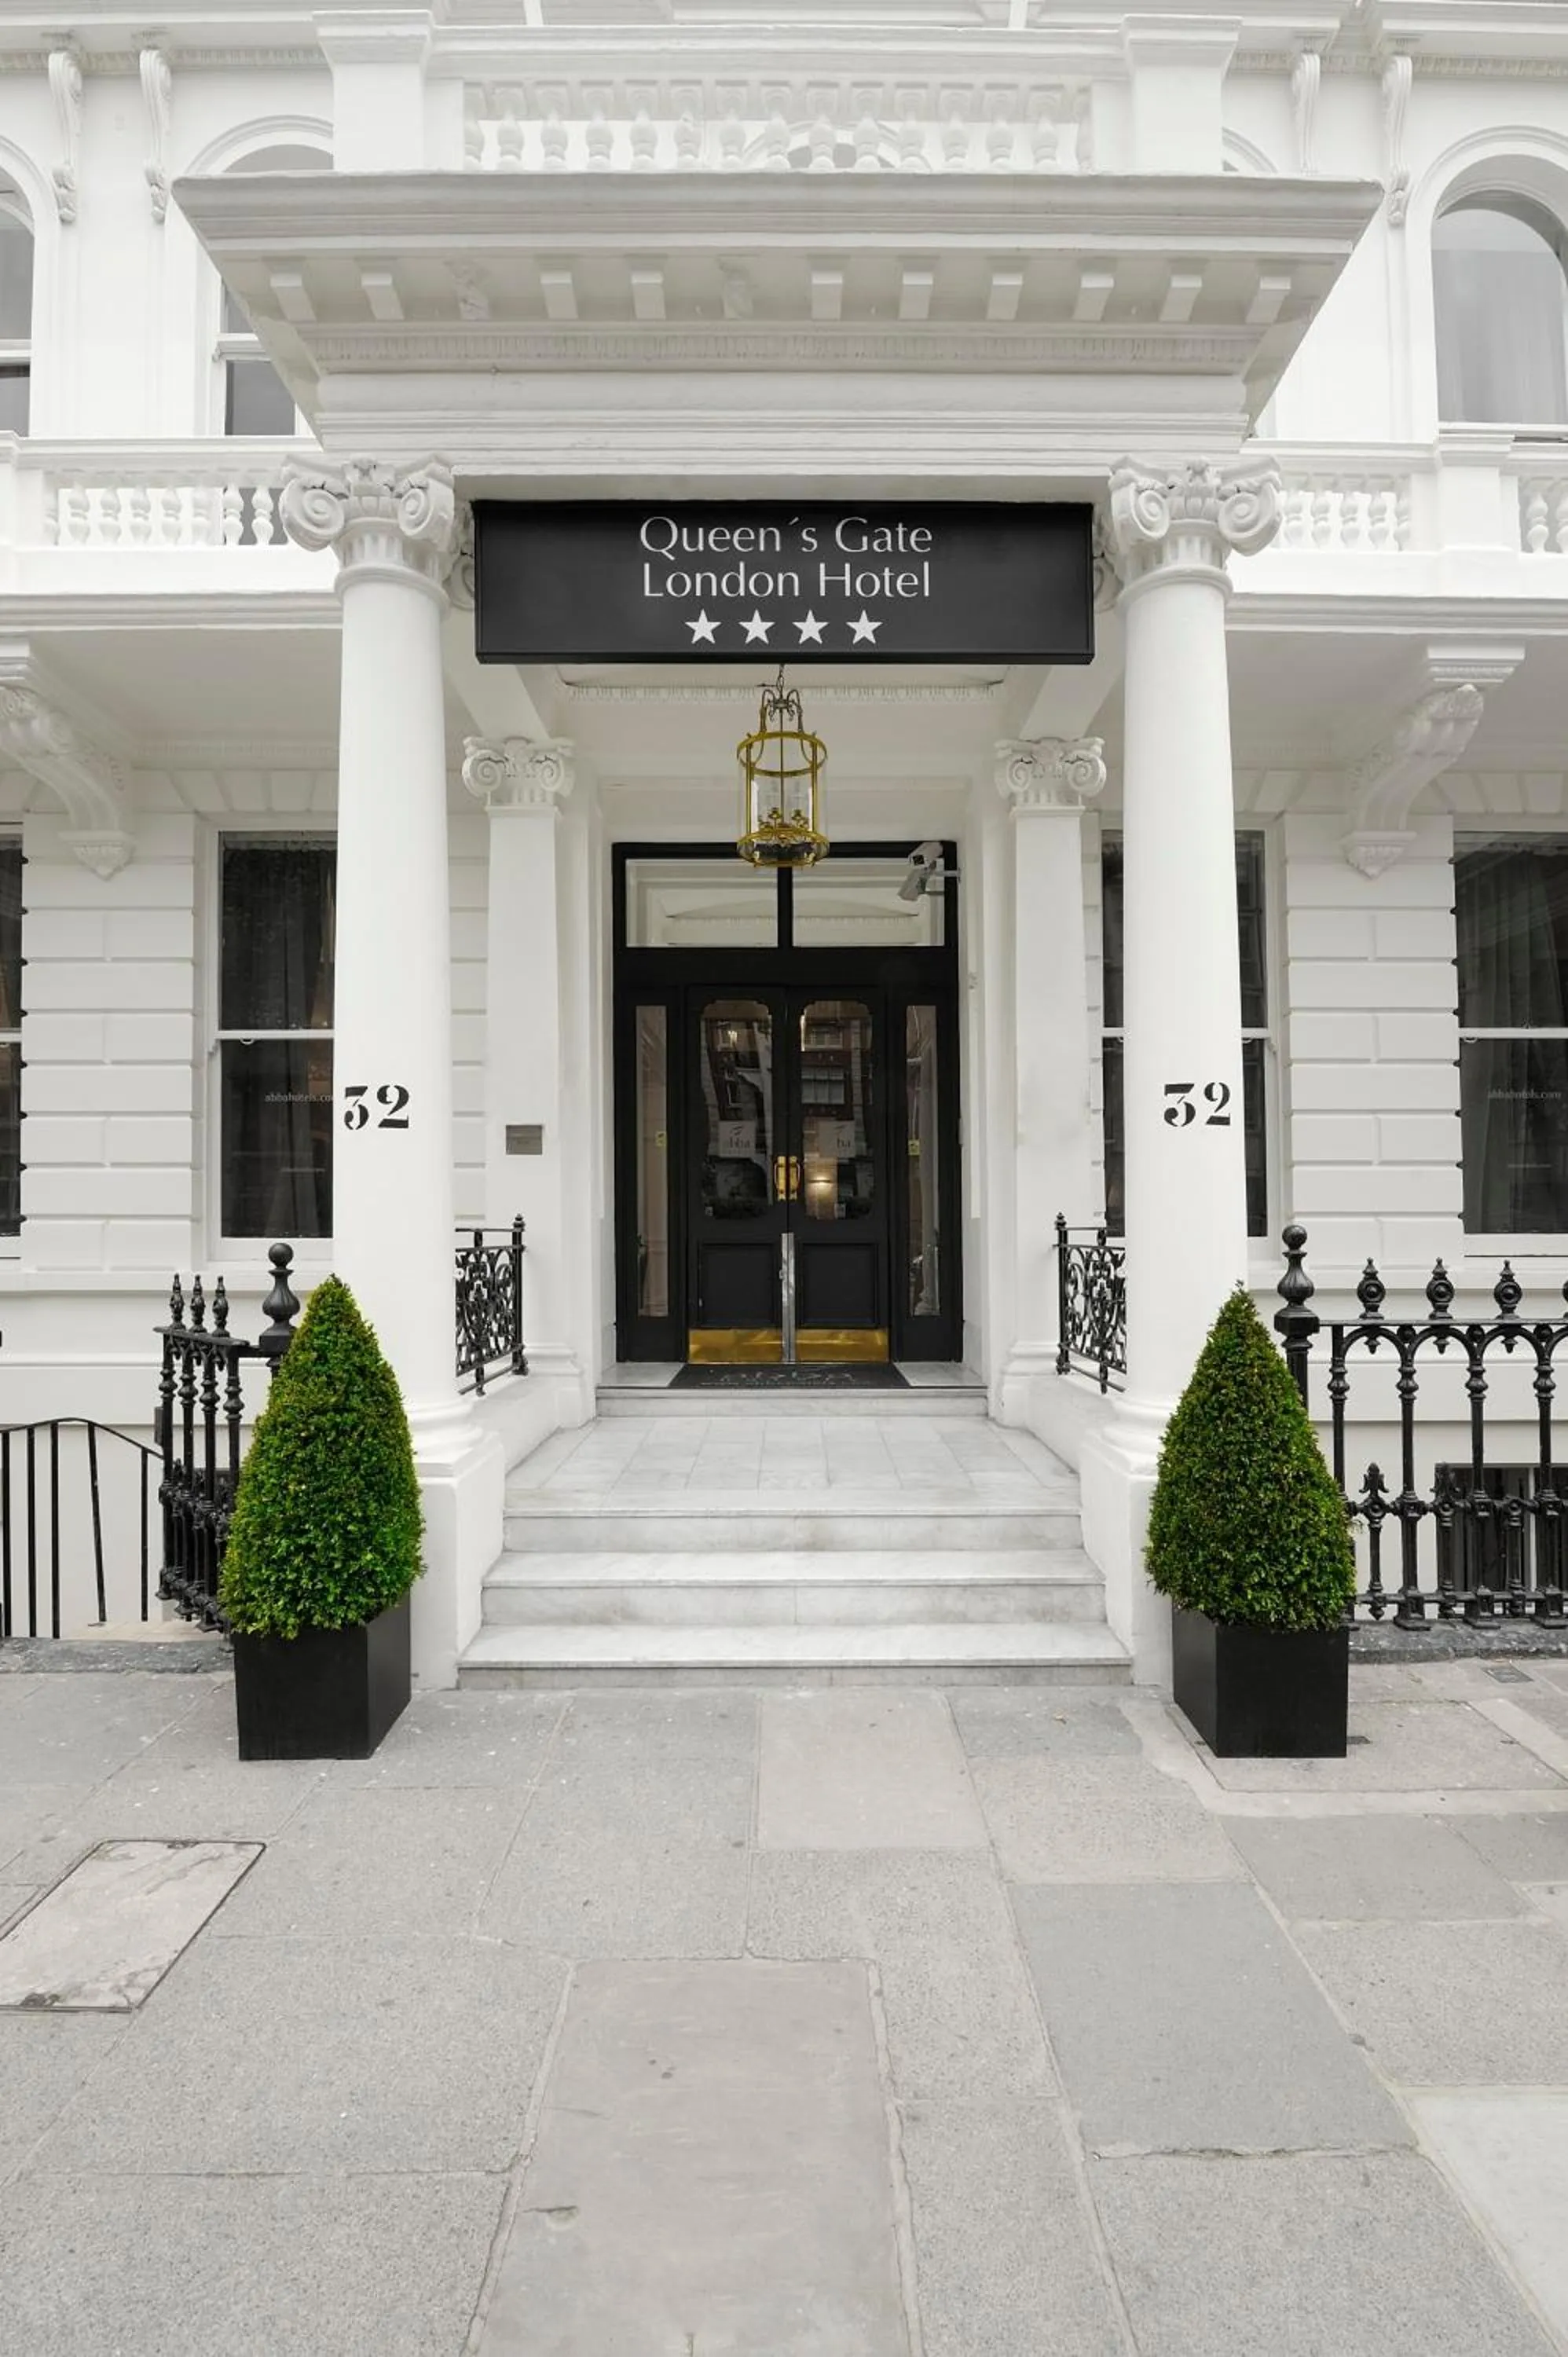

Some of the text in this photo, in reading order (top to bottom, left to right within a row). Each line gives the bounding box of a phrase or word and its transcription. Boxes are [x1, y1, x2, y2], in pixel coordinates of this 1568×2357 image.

[835, 516, 933, 553] Gate
[643, 561, 930, 598] London Hotel
[264, 1092, 333, 1102] abbahotels.co
[343, 1084, 410, 1131] 32
[1163, 1081, 1232, 1128] 32
